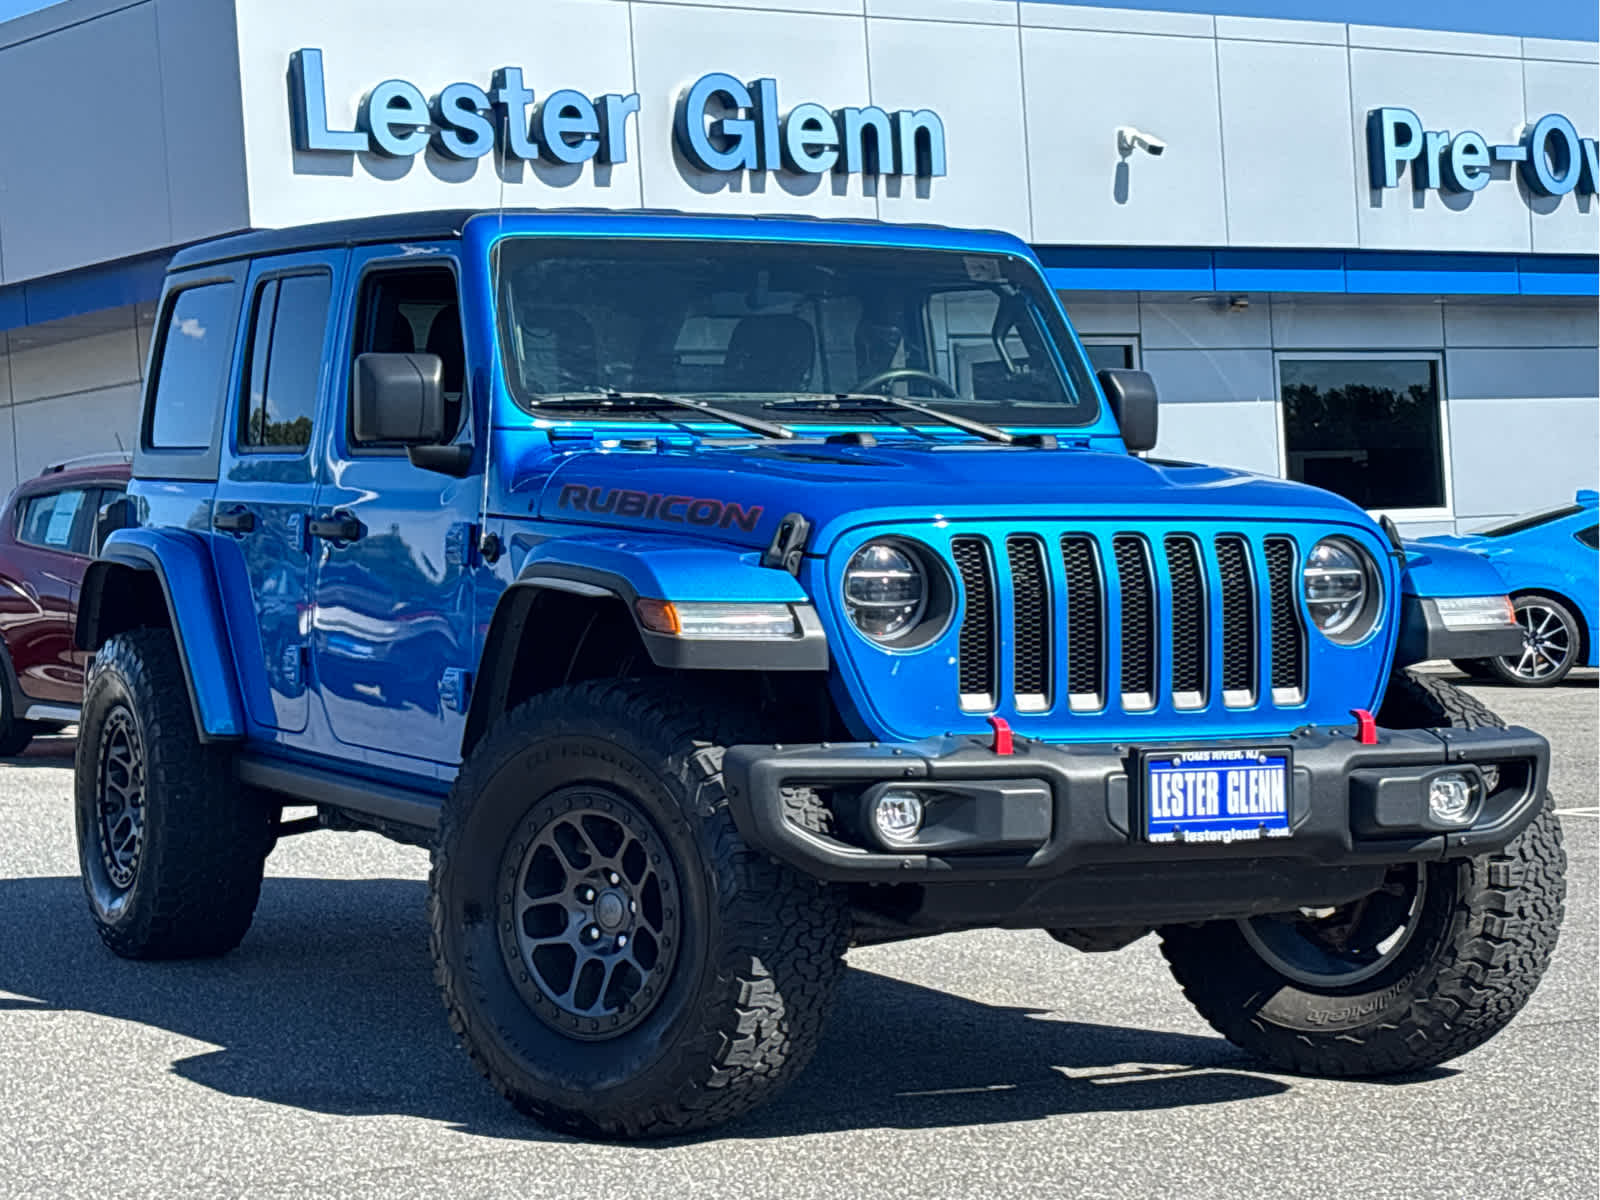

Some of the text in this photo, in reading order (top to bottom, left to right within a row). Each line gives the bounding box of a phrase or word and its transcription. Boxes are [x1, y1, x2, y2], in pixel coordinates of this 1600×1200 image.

[288, 48, 947, 177] Lester Glenn
[558, 483, 764, 532] RUBICON
[1181, 752, 1210, 762] TOMS
[1151, 769, 1286, 818] LESTER GLENN
[1183, 828, 1261, 844] lesterglenn
